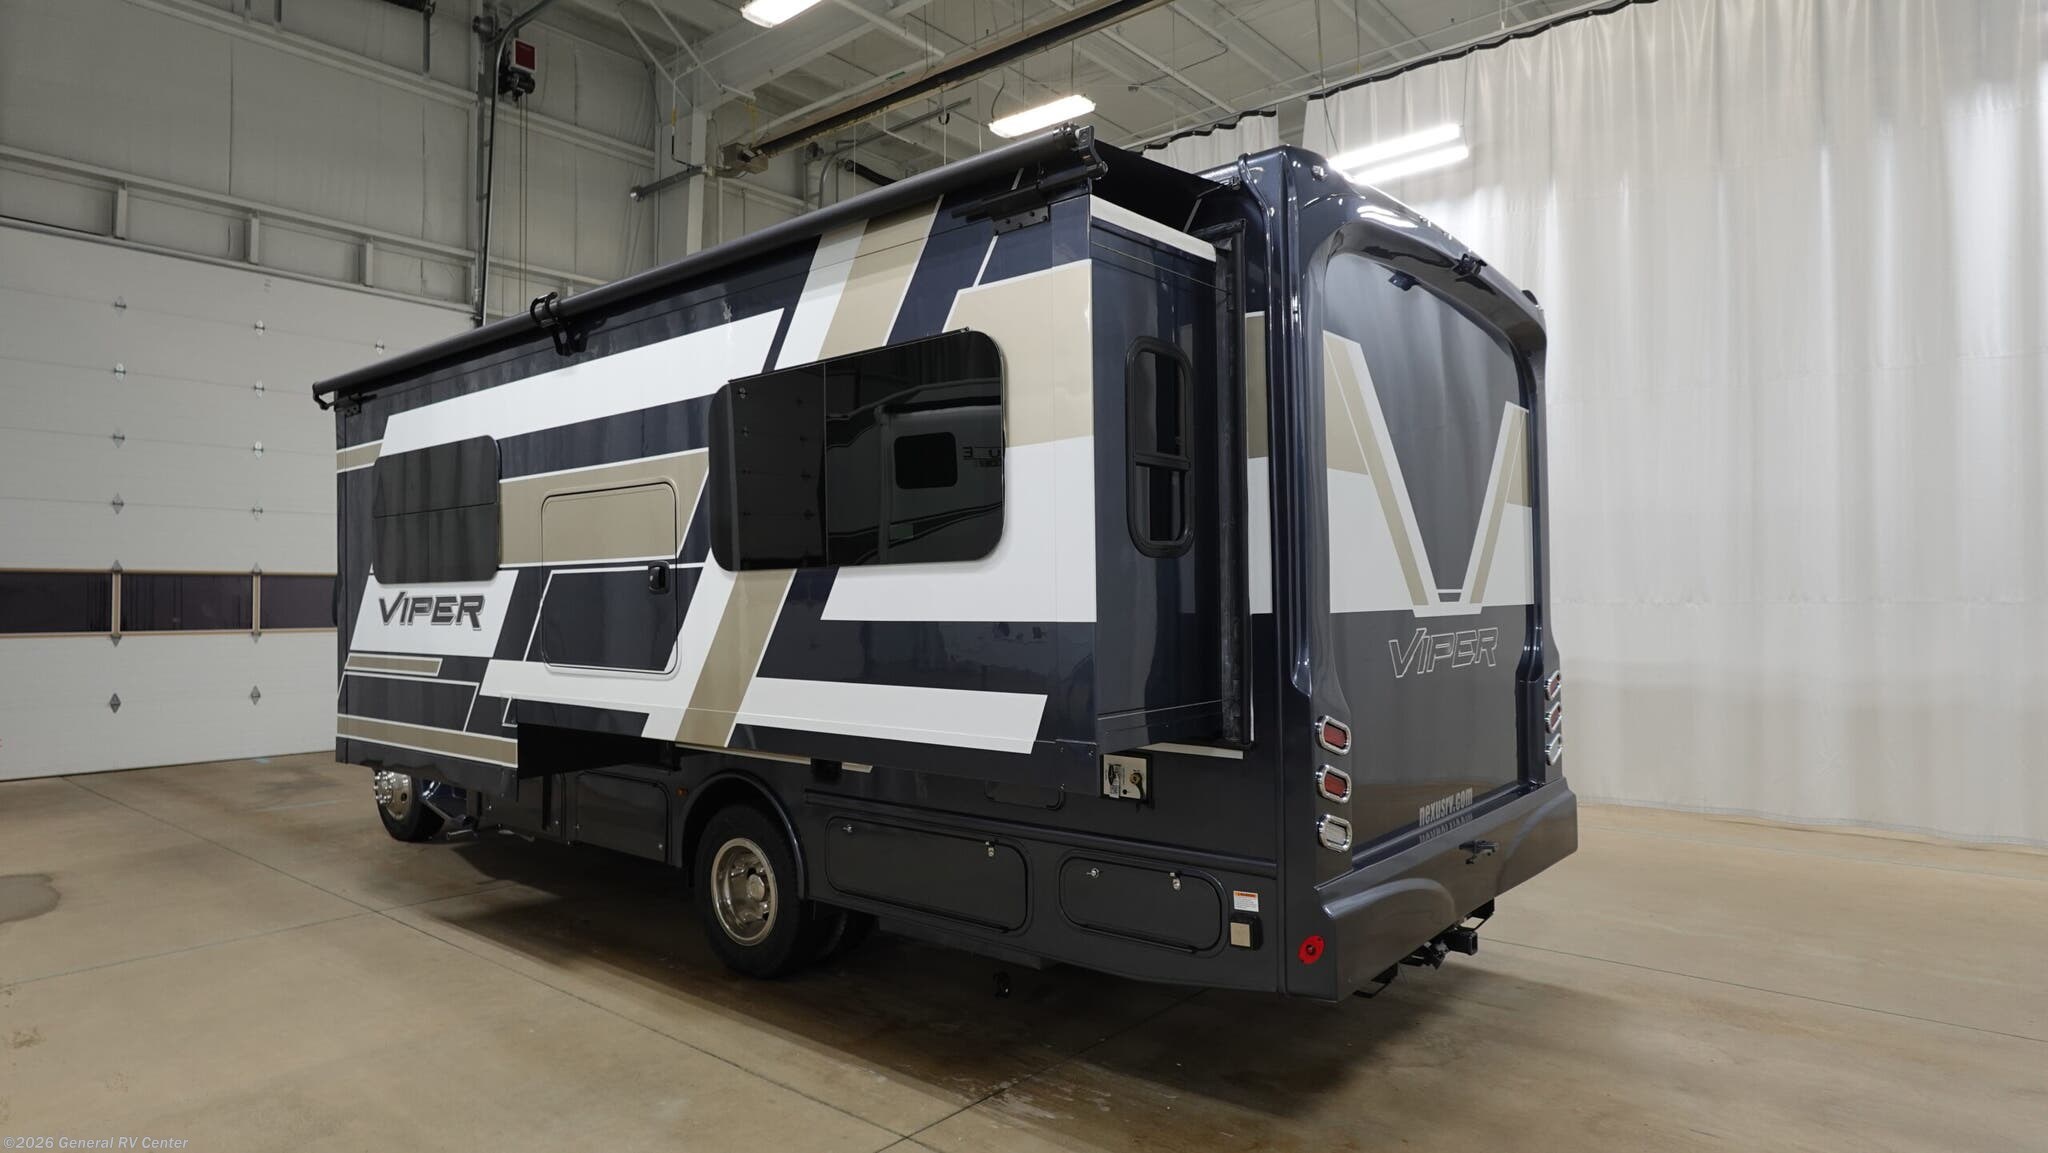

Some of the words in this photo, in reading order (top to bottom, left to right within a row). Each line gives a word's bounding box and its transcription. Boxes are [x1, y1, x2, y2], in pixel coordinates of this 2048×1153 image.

[378, 591, 485, 631] VIPER
[1388, 627, 1499, 678] VIPER
[1419, 787, 1473, 826] nexusrv.com
